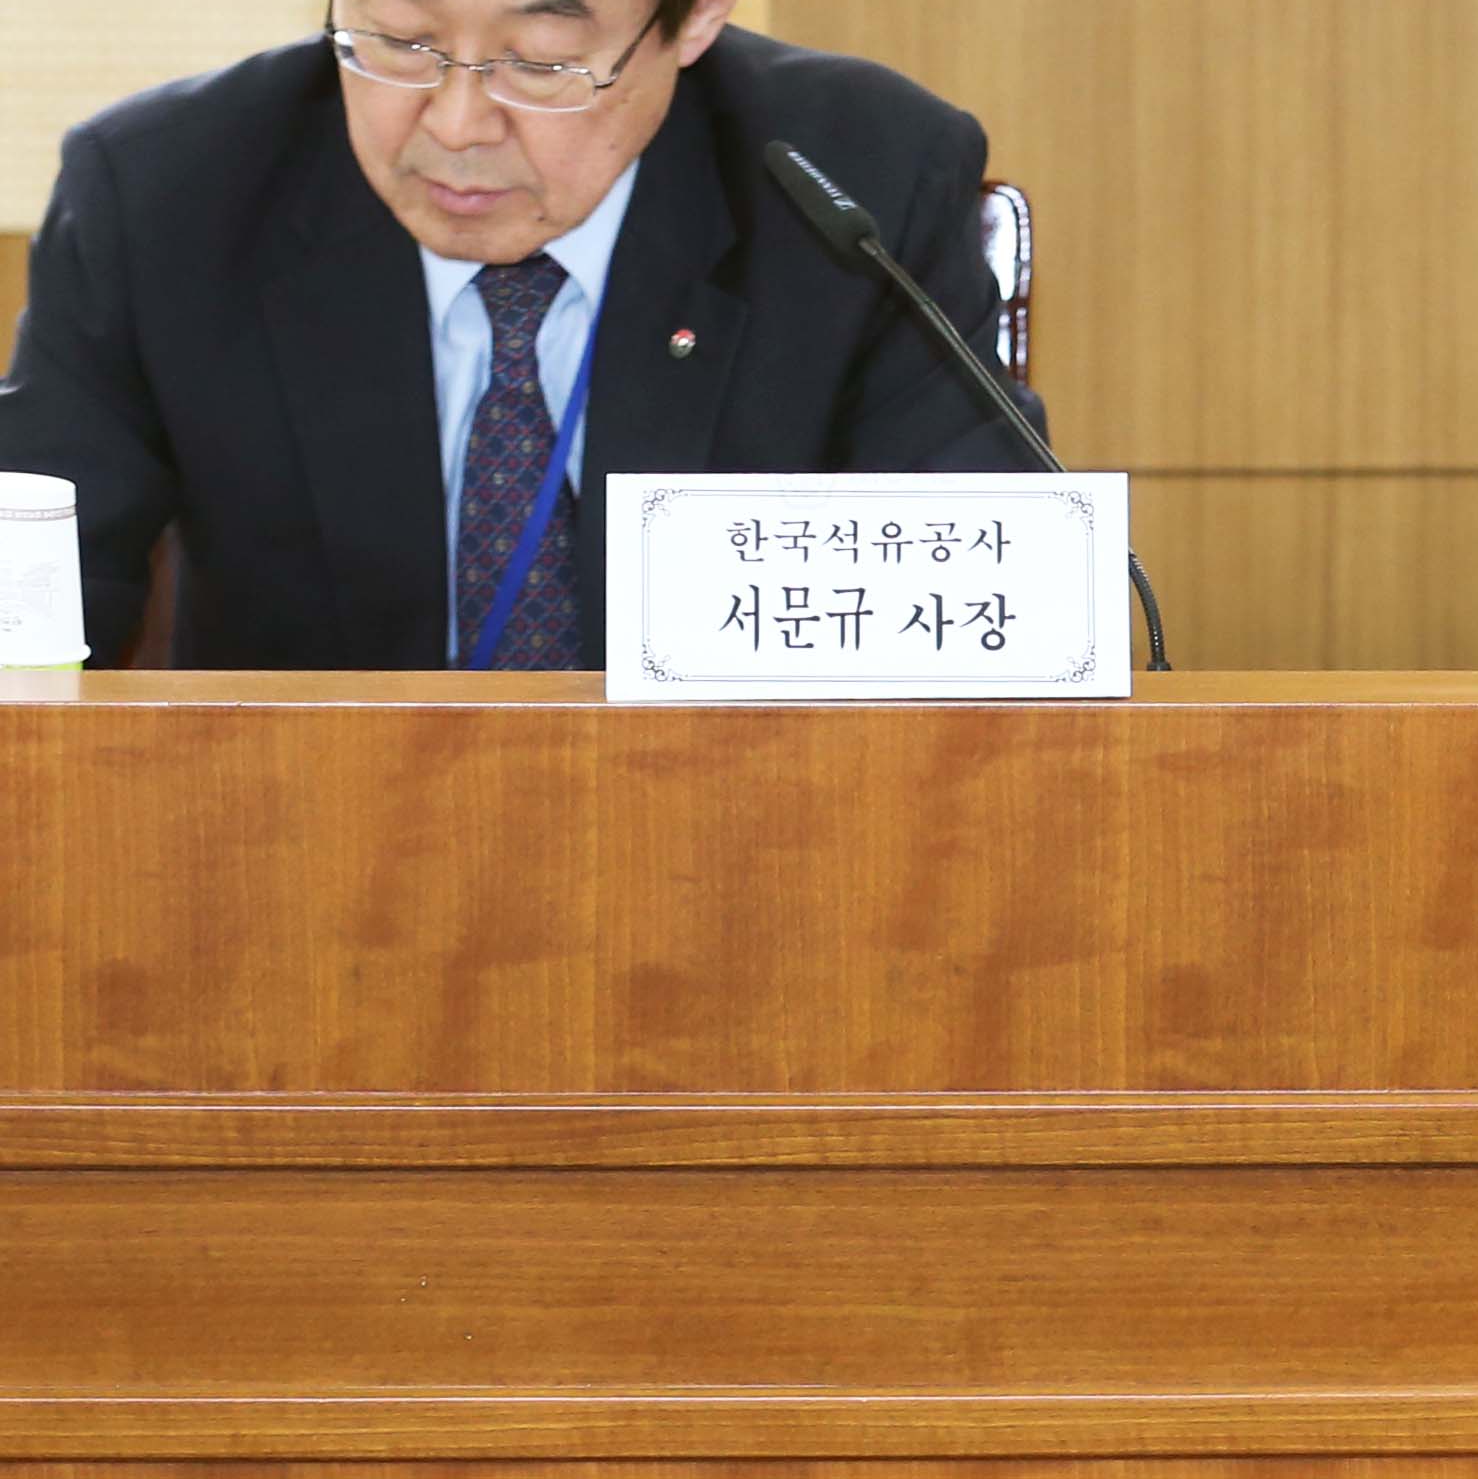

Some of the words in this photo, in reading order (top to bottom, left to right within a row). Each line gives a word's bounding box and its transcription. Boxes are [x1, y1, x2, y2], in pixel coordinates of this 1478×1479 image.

[726, 519, 1011, 564] 한국석유공사
[718, 584, 874, 652] 서문규
[898, 592, 1017, 652] 사장
